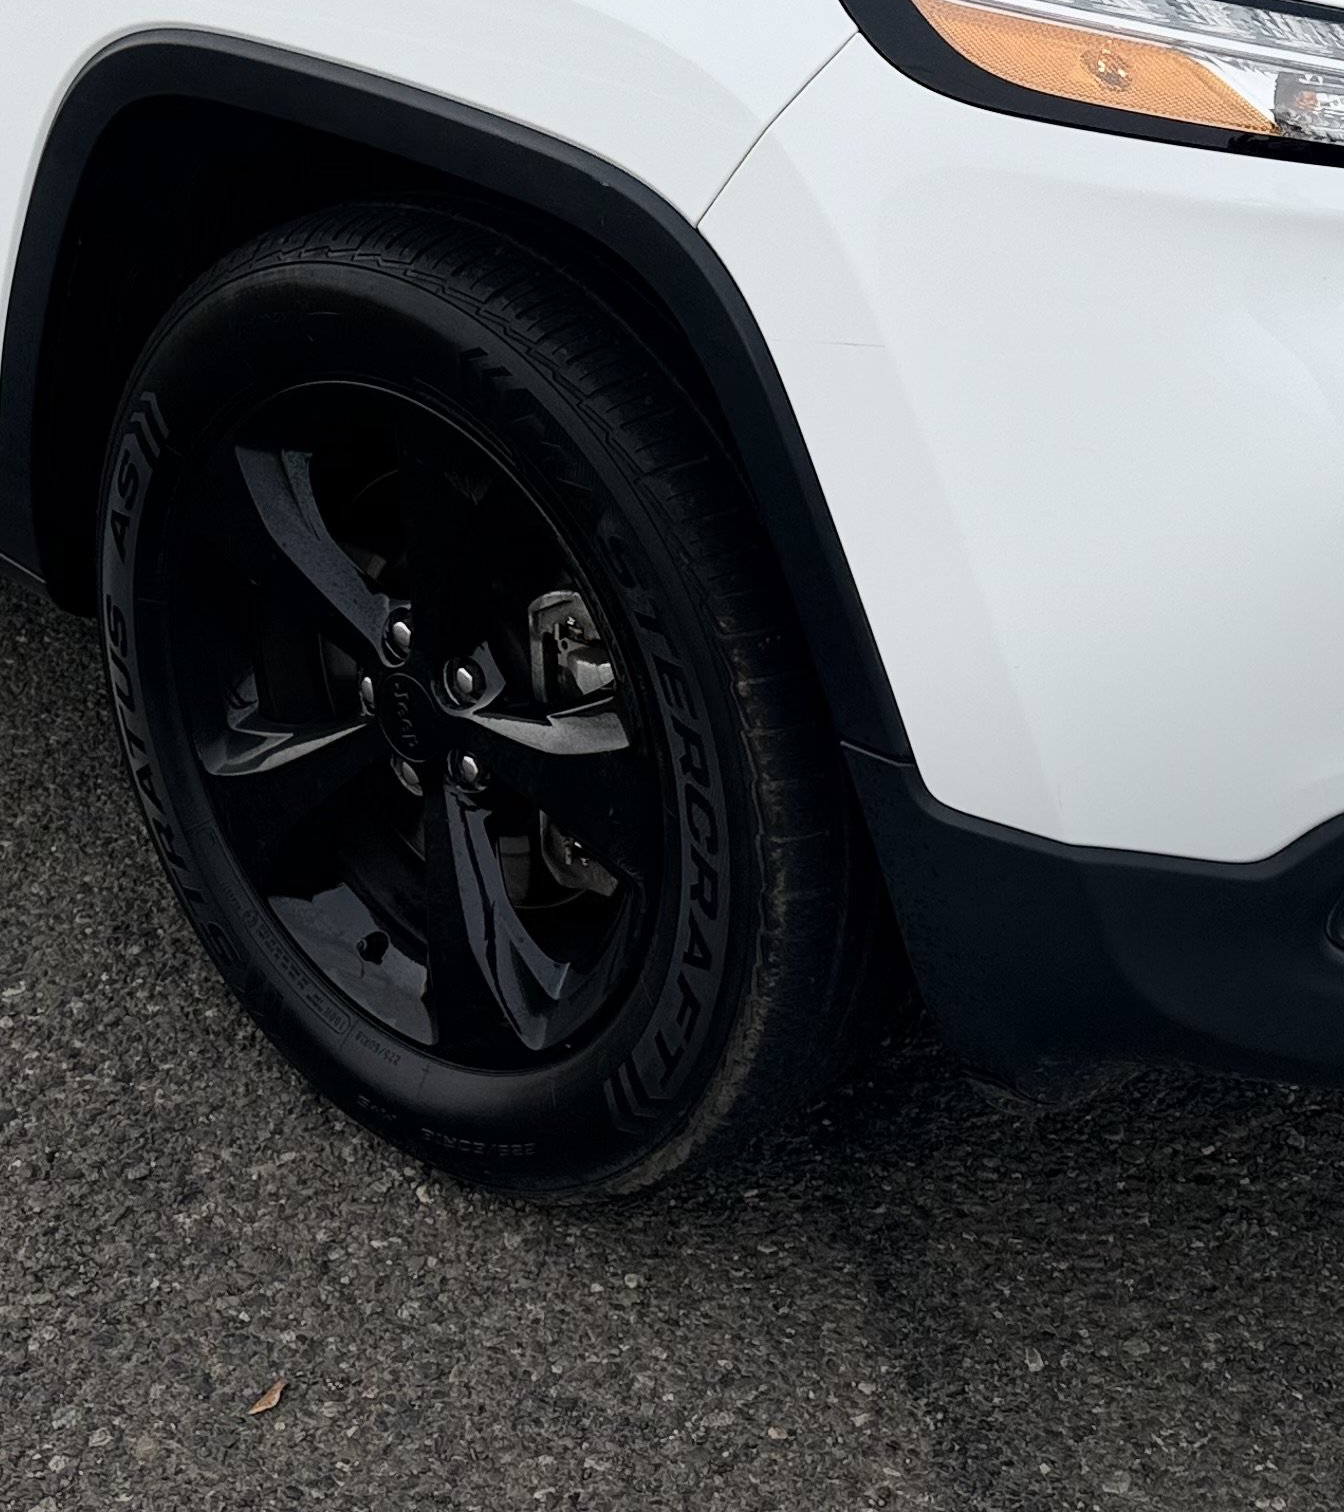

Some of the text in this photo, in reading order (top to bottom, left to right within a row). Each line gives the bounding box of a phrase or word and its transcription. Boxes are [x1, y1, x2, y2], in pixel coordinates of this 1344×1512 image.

[105, 443, 237, 968] STRATUS AS
[561, 478, 722, 1088] STERCRAFT
